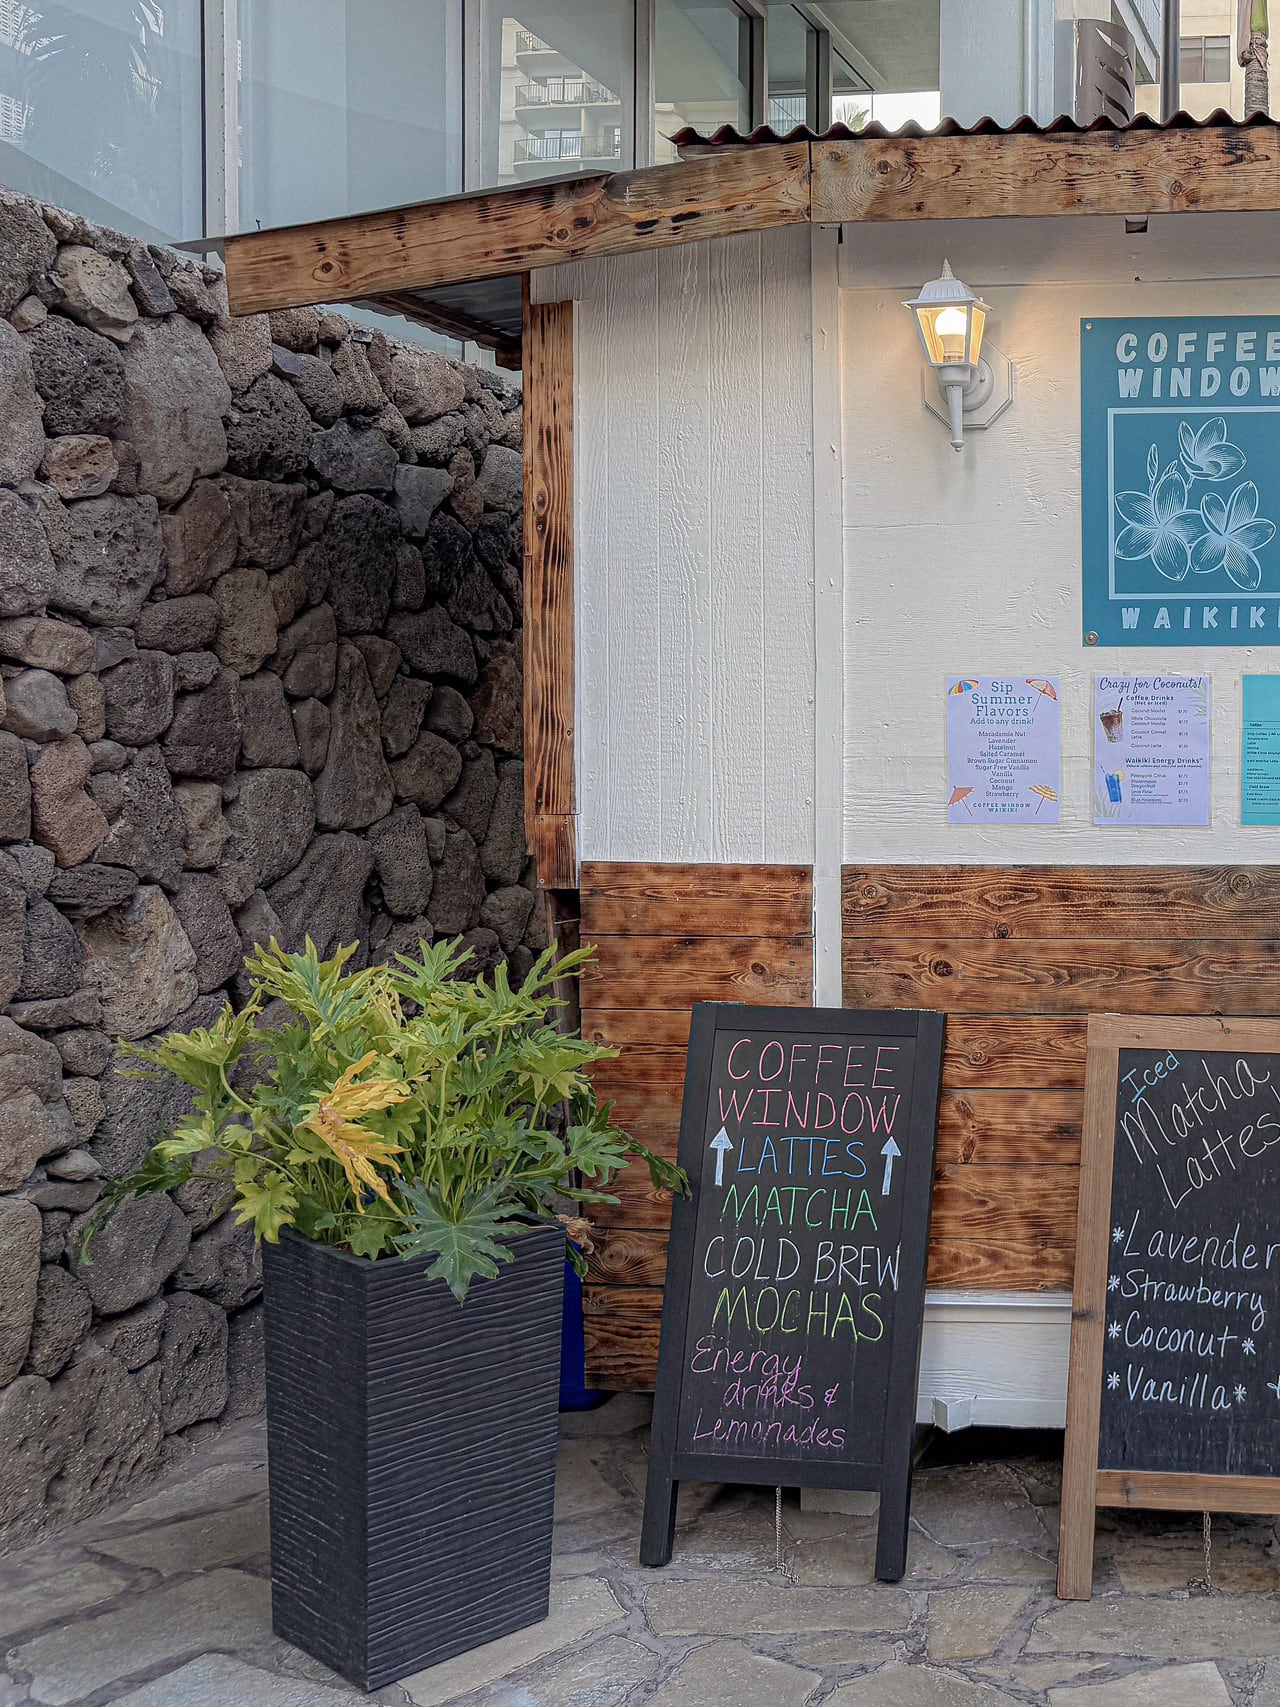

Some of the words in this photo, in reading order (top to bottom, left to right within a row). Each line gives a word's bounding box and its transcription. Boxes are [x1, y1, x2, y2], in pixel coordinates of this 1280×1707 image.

[971, 694, 1032, 704] Summer
[991, 682, 1013, 695] Sip
[1100, 677, 1130, 694] Crazy
[1133, 678, 1150, 694] for
[1153, 677, 1202, 690] Coconuts!
[976, 706, 1029, 716] Flavors
[728, 1038, 900, 1090] COFFEE
[1121, 1050, 1180, 1103] Iced
[718, 1087, 900, 1134] WINDOW
[1120, 1058, 1270, 1164] Matcha
[738, 1136, 867, 1178] LATTES
[720, 1184, 878, 1232] MATCHA
[704, 1236, 800, 1281] COLD
[814, 1242, 900, 1292] BREW
[713, 1287, 884, 1342] MOCHAS
[1120, 1268, 1266, 1332] Strawberry
[1124, 1311, 1238, 1358] Coconut
[691, 1336, 802, 1389] Energy
[724, 1376, 816, 1410] drinks
[1126, 1363, 1232, 1410] Vanilla
[693, 1408, 846, 1448] Lemonades
